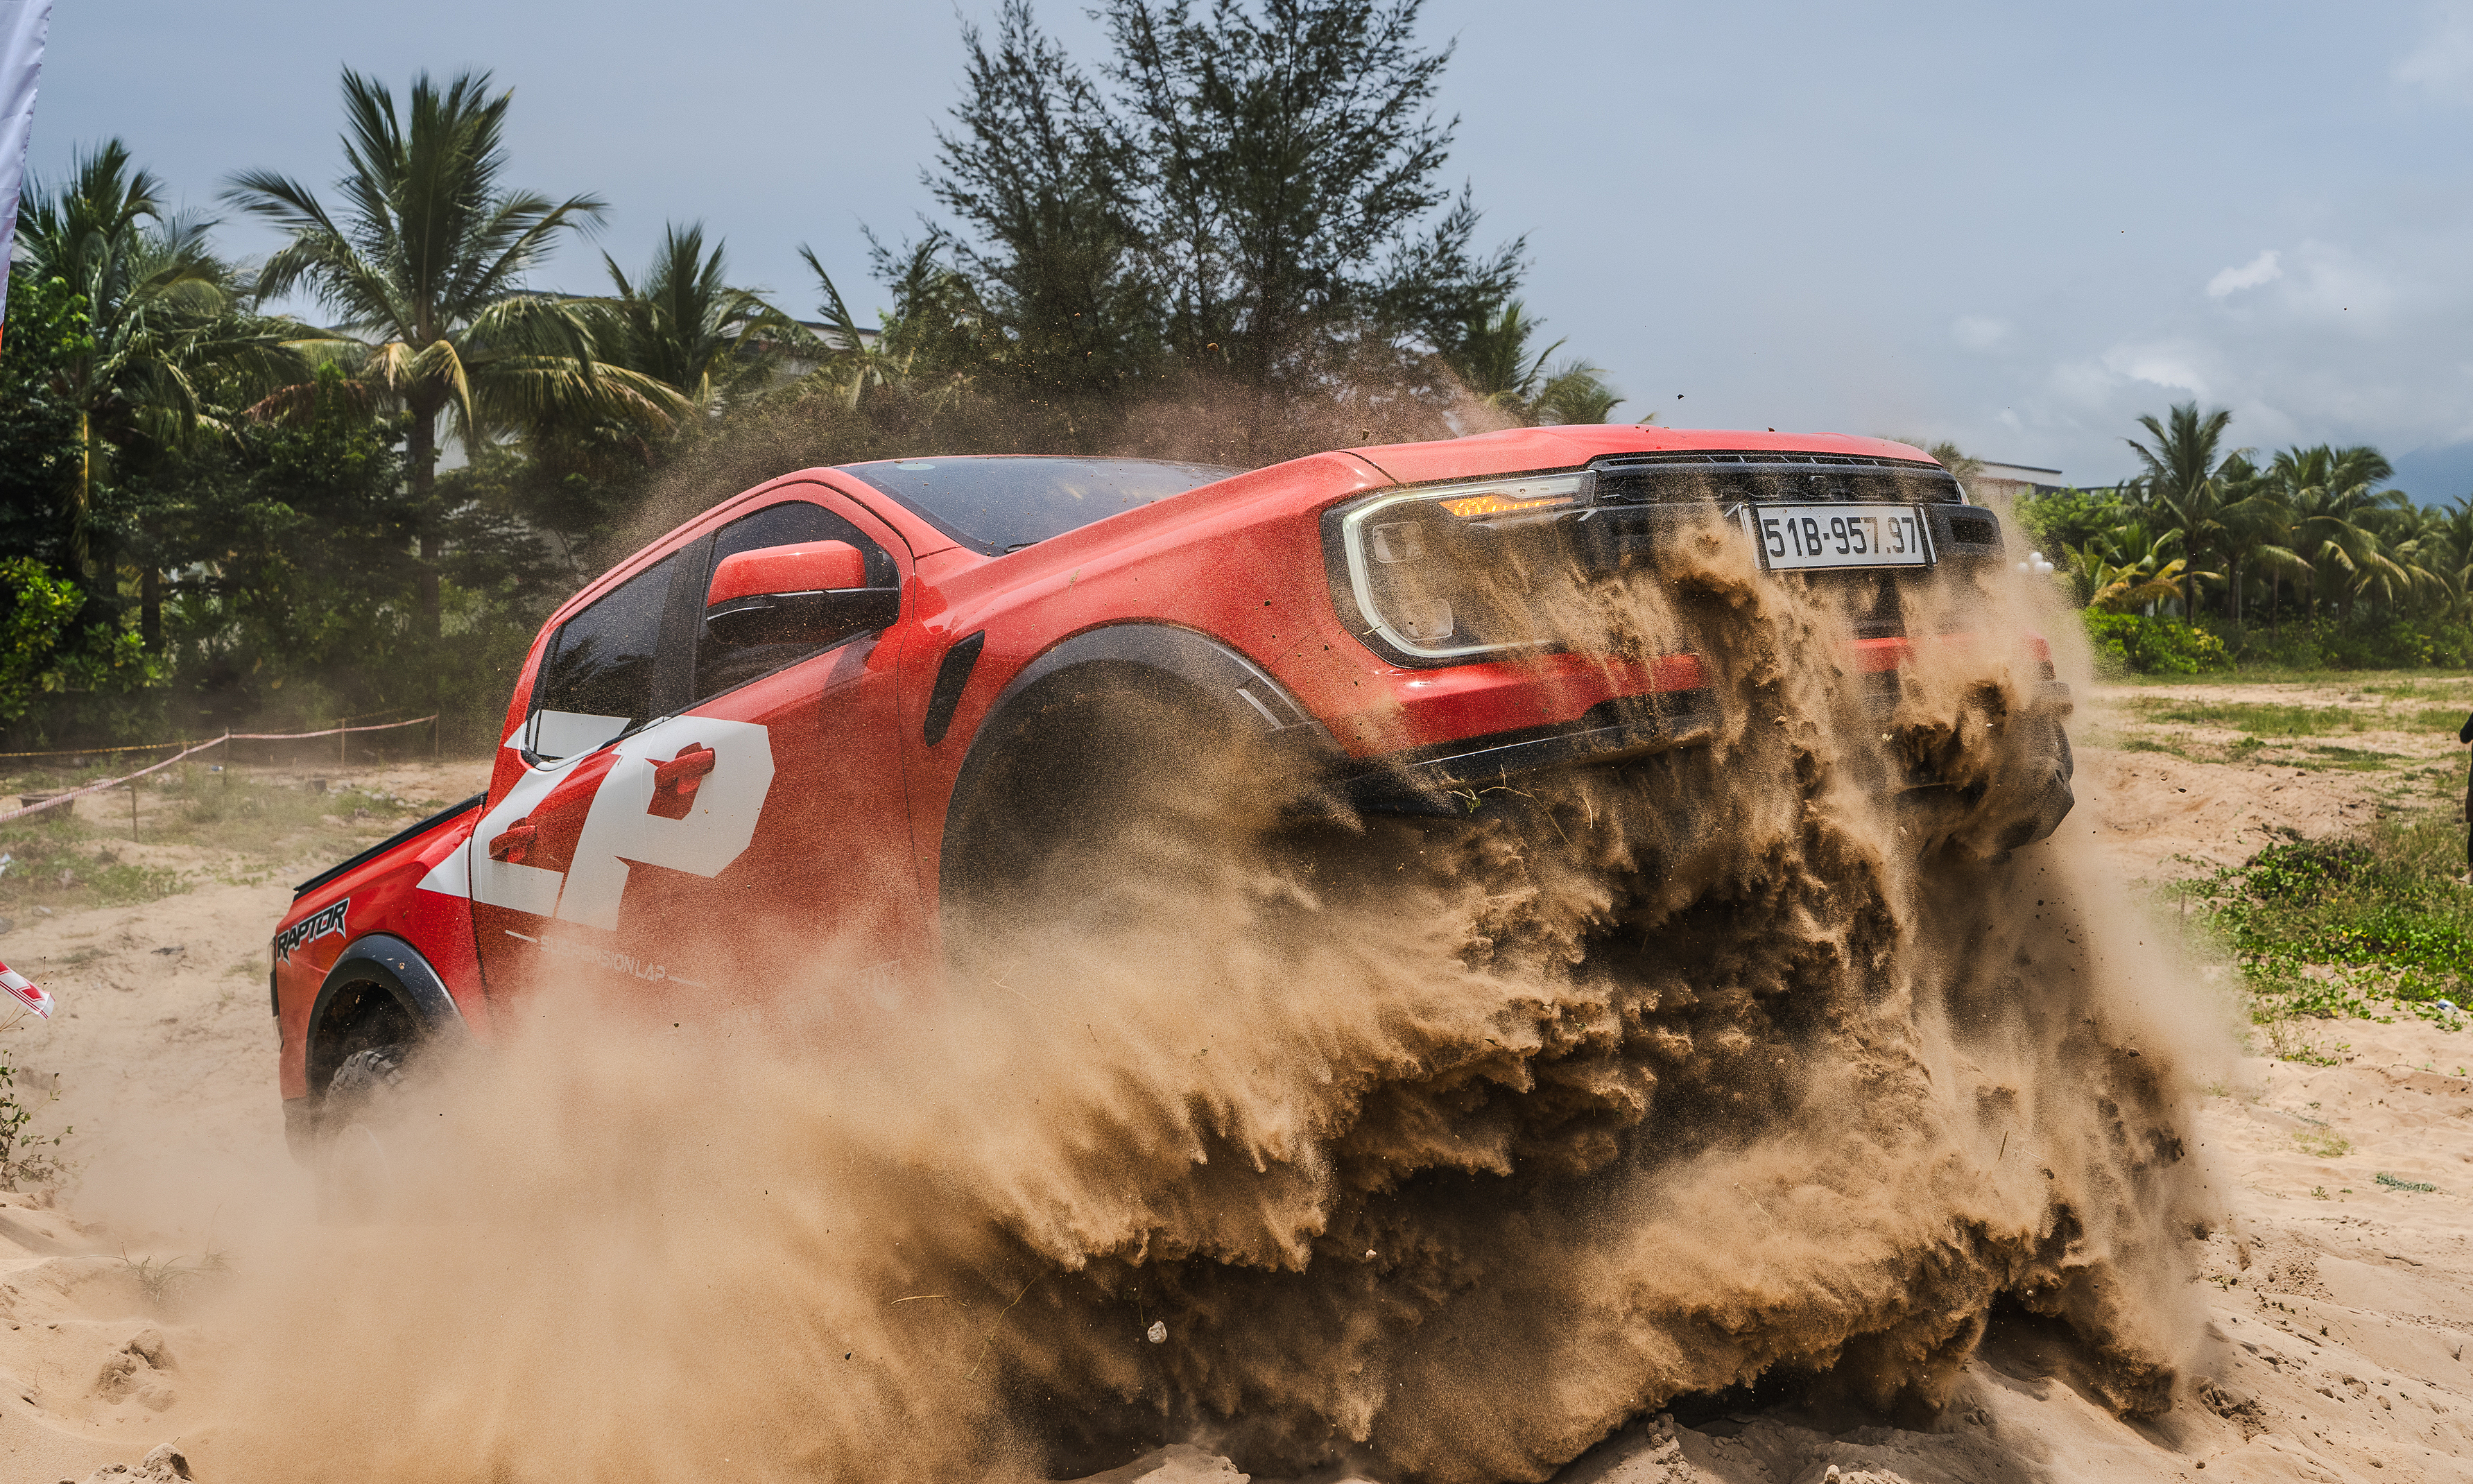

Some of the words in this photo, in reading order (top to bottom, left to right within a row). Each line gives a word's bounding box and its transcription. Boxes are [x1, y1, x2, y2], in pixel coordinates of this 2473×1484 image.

[1762, 517, 1916, 558] 51B-957.97
[277, 897, 350, 967] RAPTOR
[540, 935, 635, 974] SUENSION
